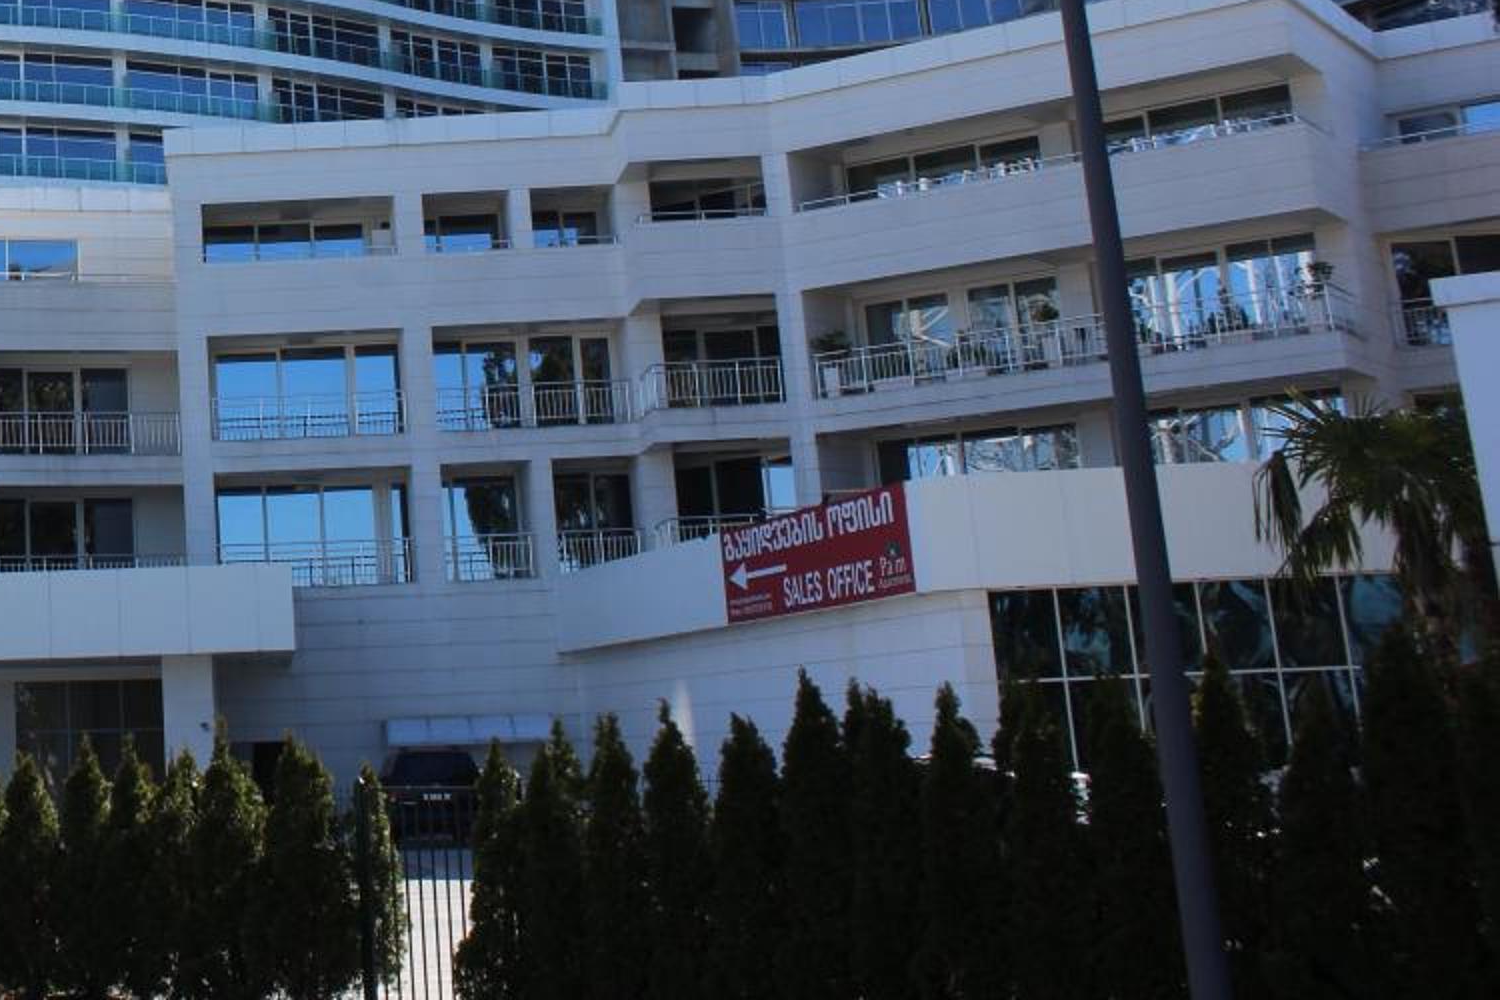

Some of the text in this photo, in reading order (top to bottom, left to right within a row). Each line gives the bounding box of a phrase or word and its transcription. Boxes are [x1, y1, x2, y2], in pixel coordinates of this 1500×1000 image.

[723, 491, 895, 562] გაყიდვების ოფისი
[783, 569, 823, 609] SALES
[827, 559, 876, 600] OFFICE
